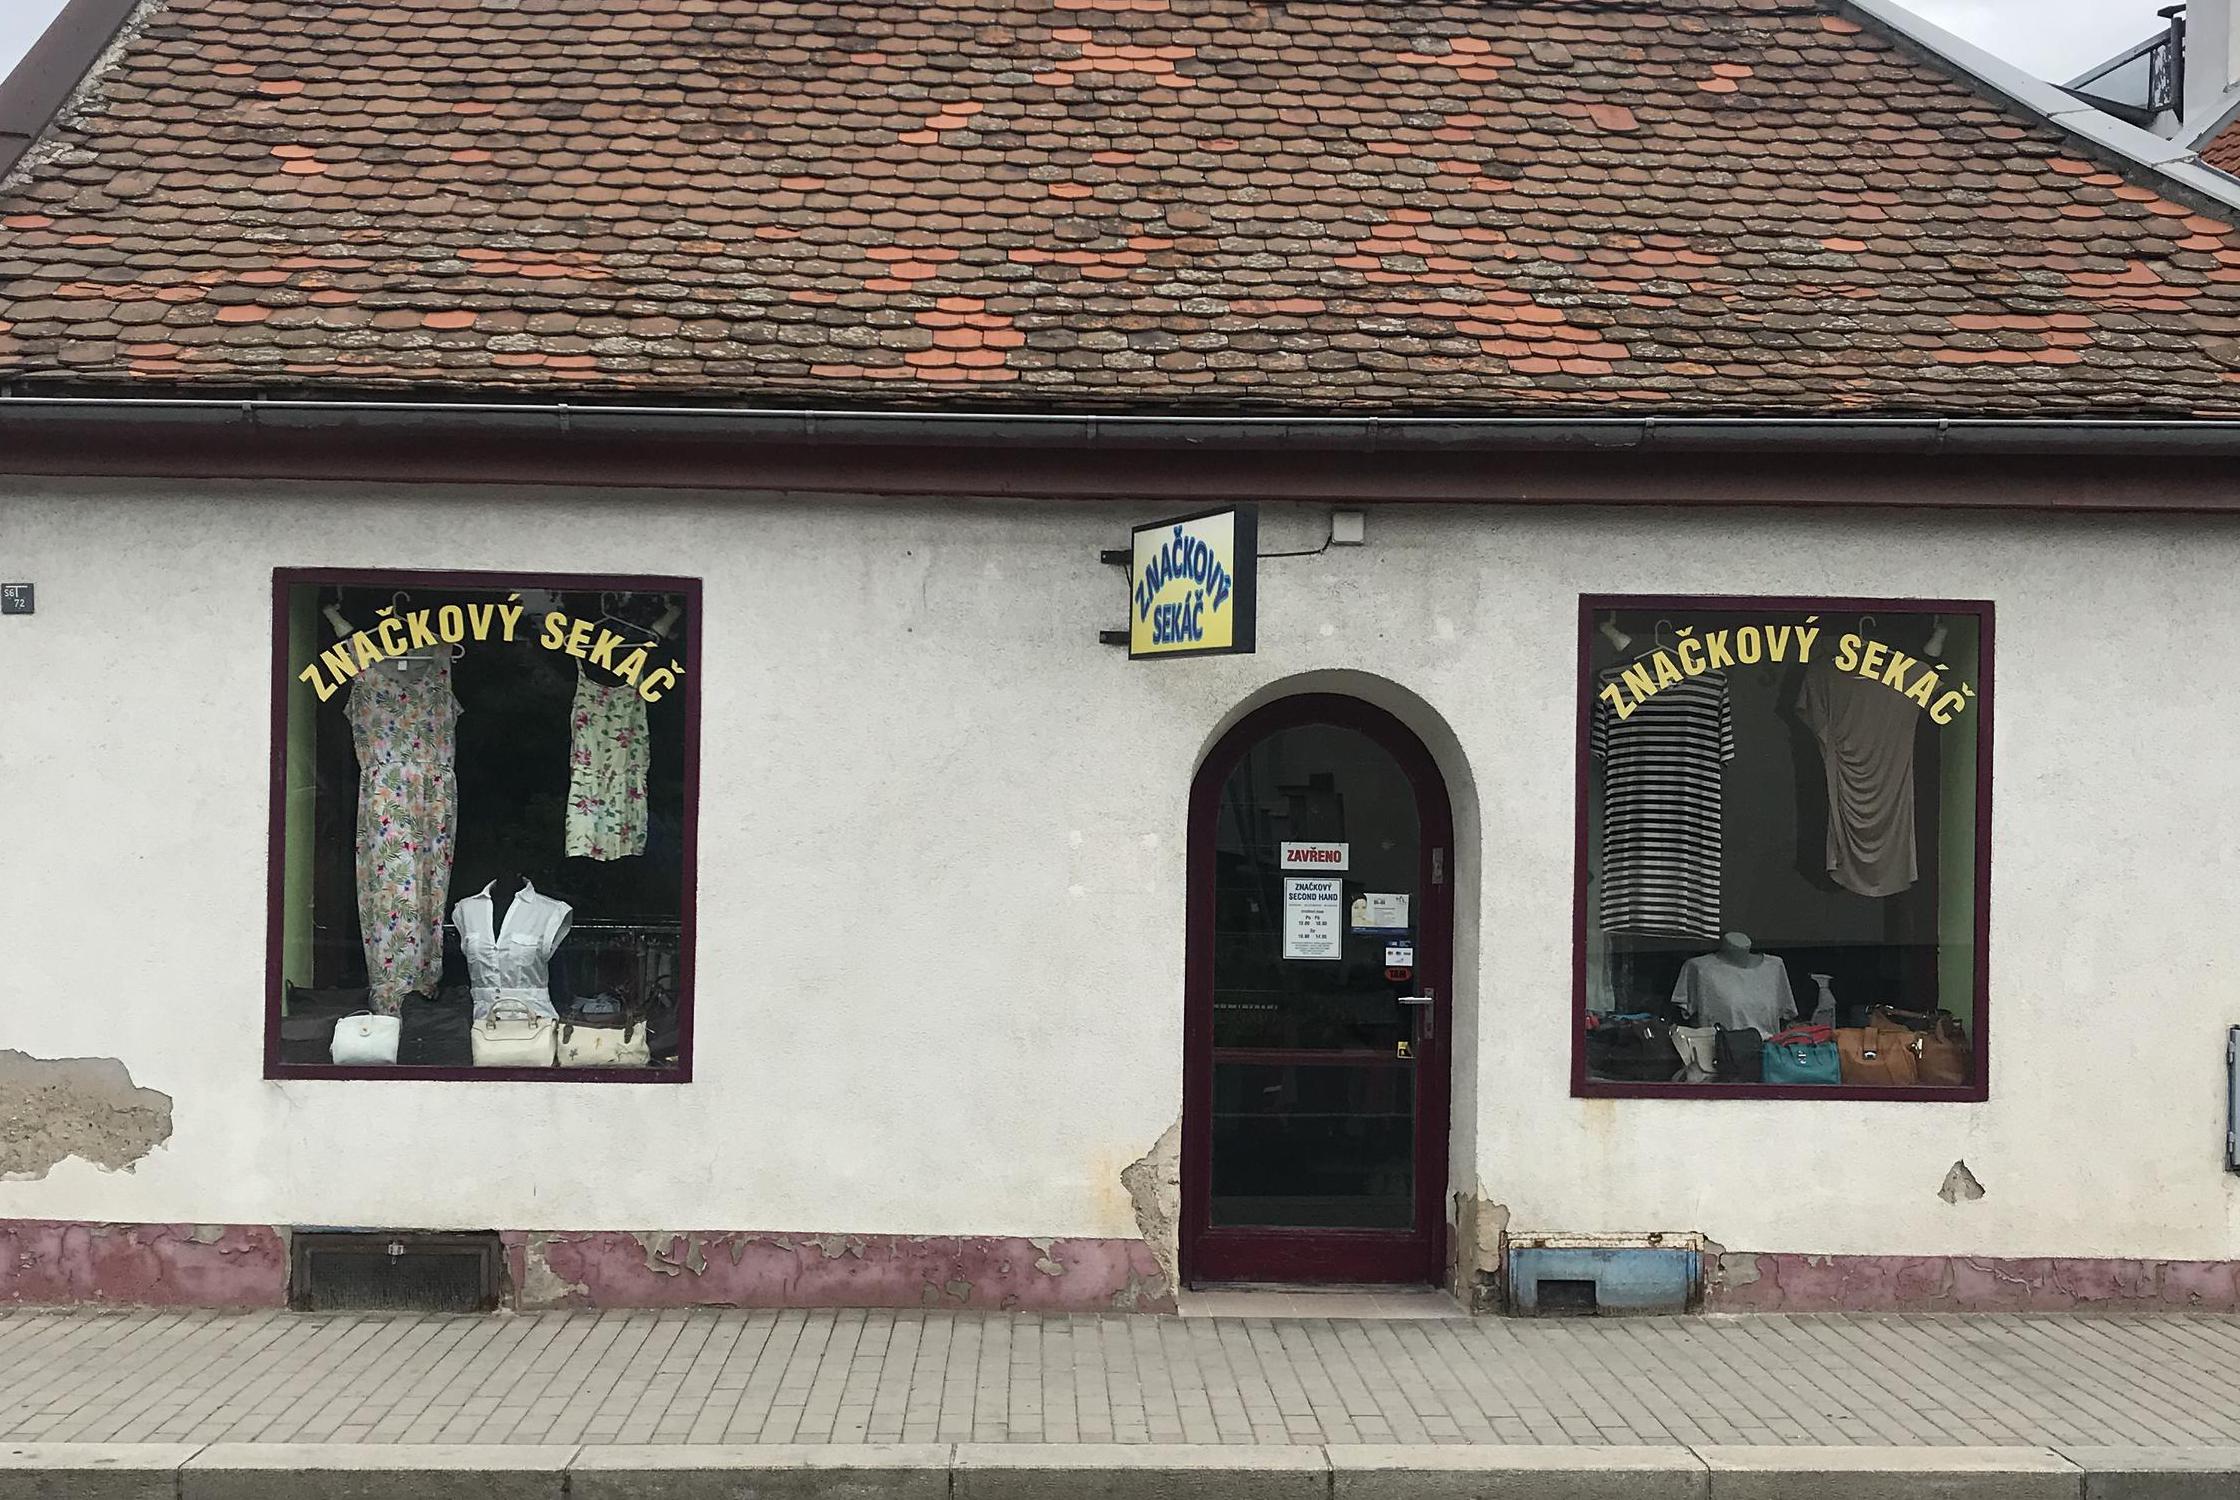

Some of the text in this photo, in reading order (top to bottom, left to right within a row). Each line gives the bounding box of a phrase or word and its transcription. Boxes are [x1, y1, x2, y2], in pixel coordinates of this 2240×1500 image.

[1134, 524, 1232, 624] ZNAČKOVÝ
[13, 598, 26, 609] 72
[1152, 588, 1205, 646] SEKÁČ
[298, 593, 687, 703] ZNAČKOVÝ SEKÁČ
[1599, 615, 1977, 726] ZNAČKOVÝ SEKÁČ
[1286, 846, 1343, 864] ZAVŘENO
[1288, 892, 1339, 901] SECOND HAND
[1294, 881, 1333, 892] ZNAČKOVÝ
